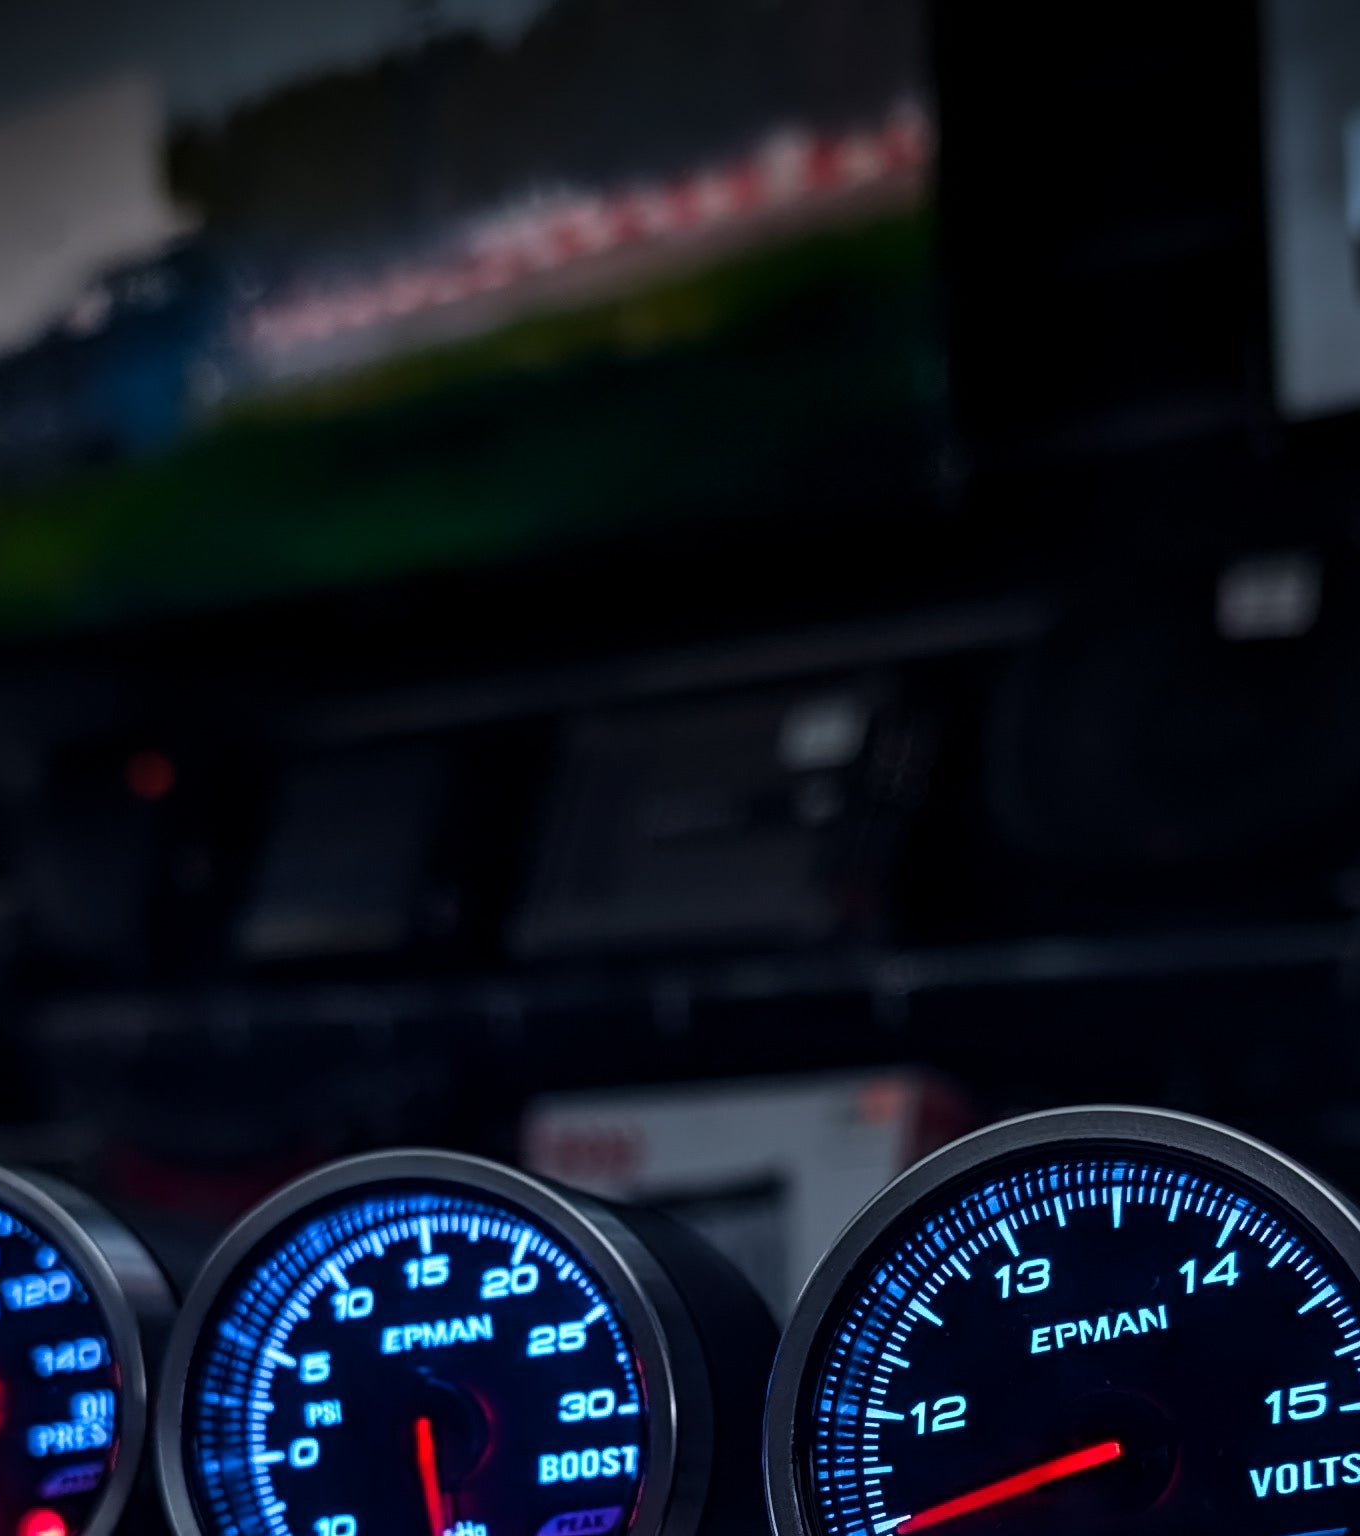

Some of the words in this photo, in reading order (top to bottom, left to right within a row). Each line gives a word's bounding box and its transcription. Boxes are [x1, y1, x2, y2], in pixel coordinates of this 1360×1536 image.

[402, 1251, 450, 1290] 15
[479, 1262, 540, 1300] 20
[994, 1258, 1050, 1298] 13
[1179, 1251, 1240, 1294] 14
[2, 1271, 72, 1310] 120
[330, 1285, 374, 1322] 10
[380, 1313, 494, 1354] EPMAN
[526, 1320, 589, 1358] 25
[1031, 1304, 1168, 1354] EPMAN
[32, 1337, 103, 1376] 140
[298, 1350, 331, 1385] 5
[303, 1399, 342, 1428] PSI
[558, 1387, 618, 1423] 30
[910, 1395, 966, 1434] 12
[1265, 1382, 1328, 1424] 15
[287, 1436, 320, 1469] 0
[538, 1444, 639, 1485] BOOST
